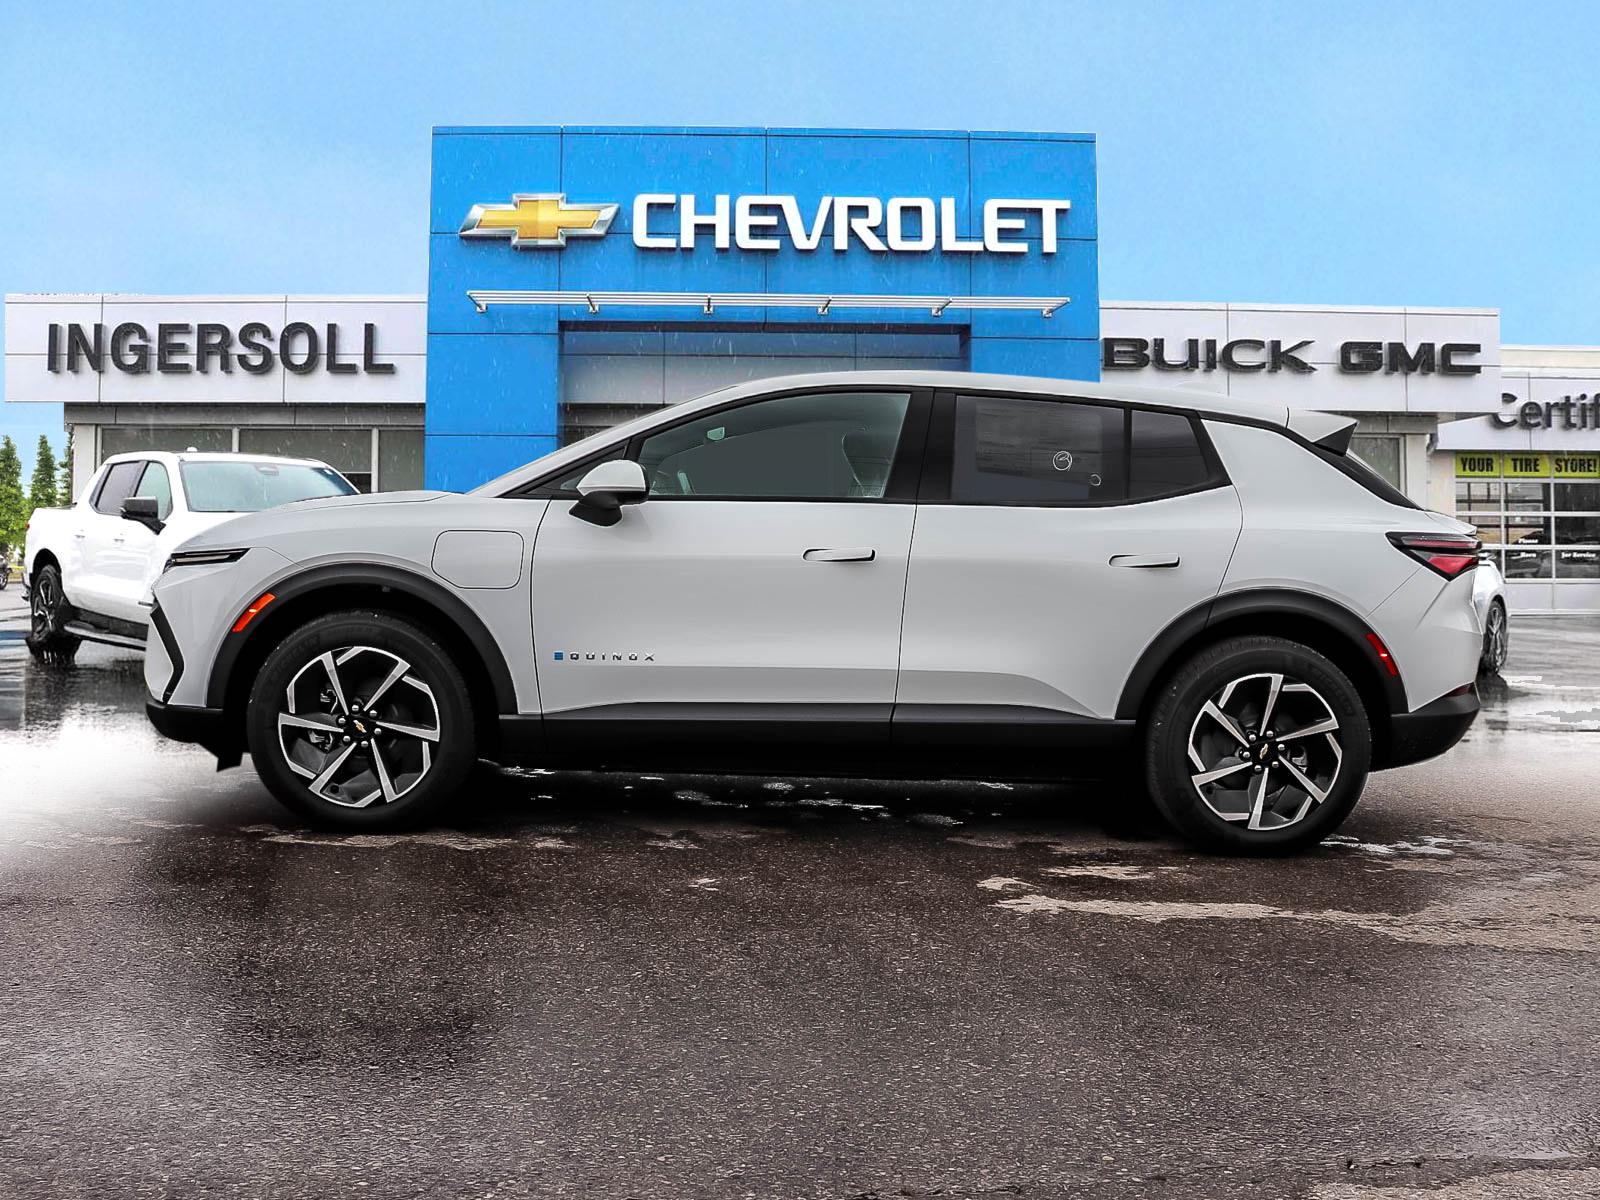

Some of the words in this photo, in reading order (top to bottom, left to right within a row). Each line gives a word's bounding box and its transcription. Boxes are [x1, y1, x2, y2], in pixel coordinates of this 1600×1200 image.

[633, 193, 1071, 255] CHEVROLET
[47, 322, 395, 375] INGERSOLL
[1102, 337, 1318, 373] BUICK
[1340, 341, 1482, 375] GMC
[1460, 457, 1494, 473] YOUR
[1511, 457, 1540, 473] TIRE
[1555, 457, 1597, 473] STORE!
